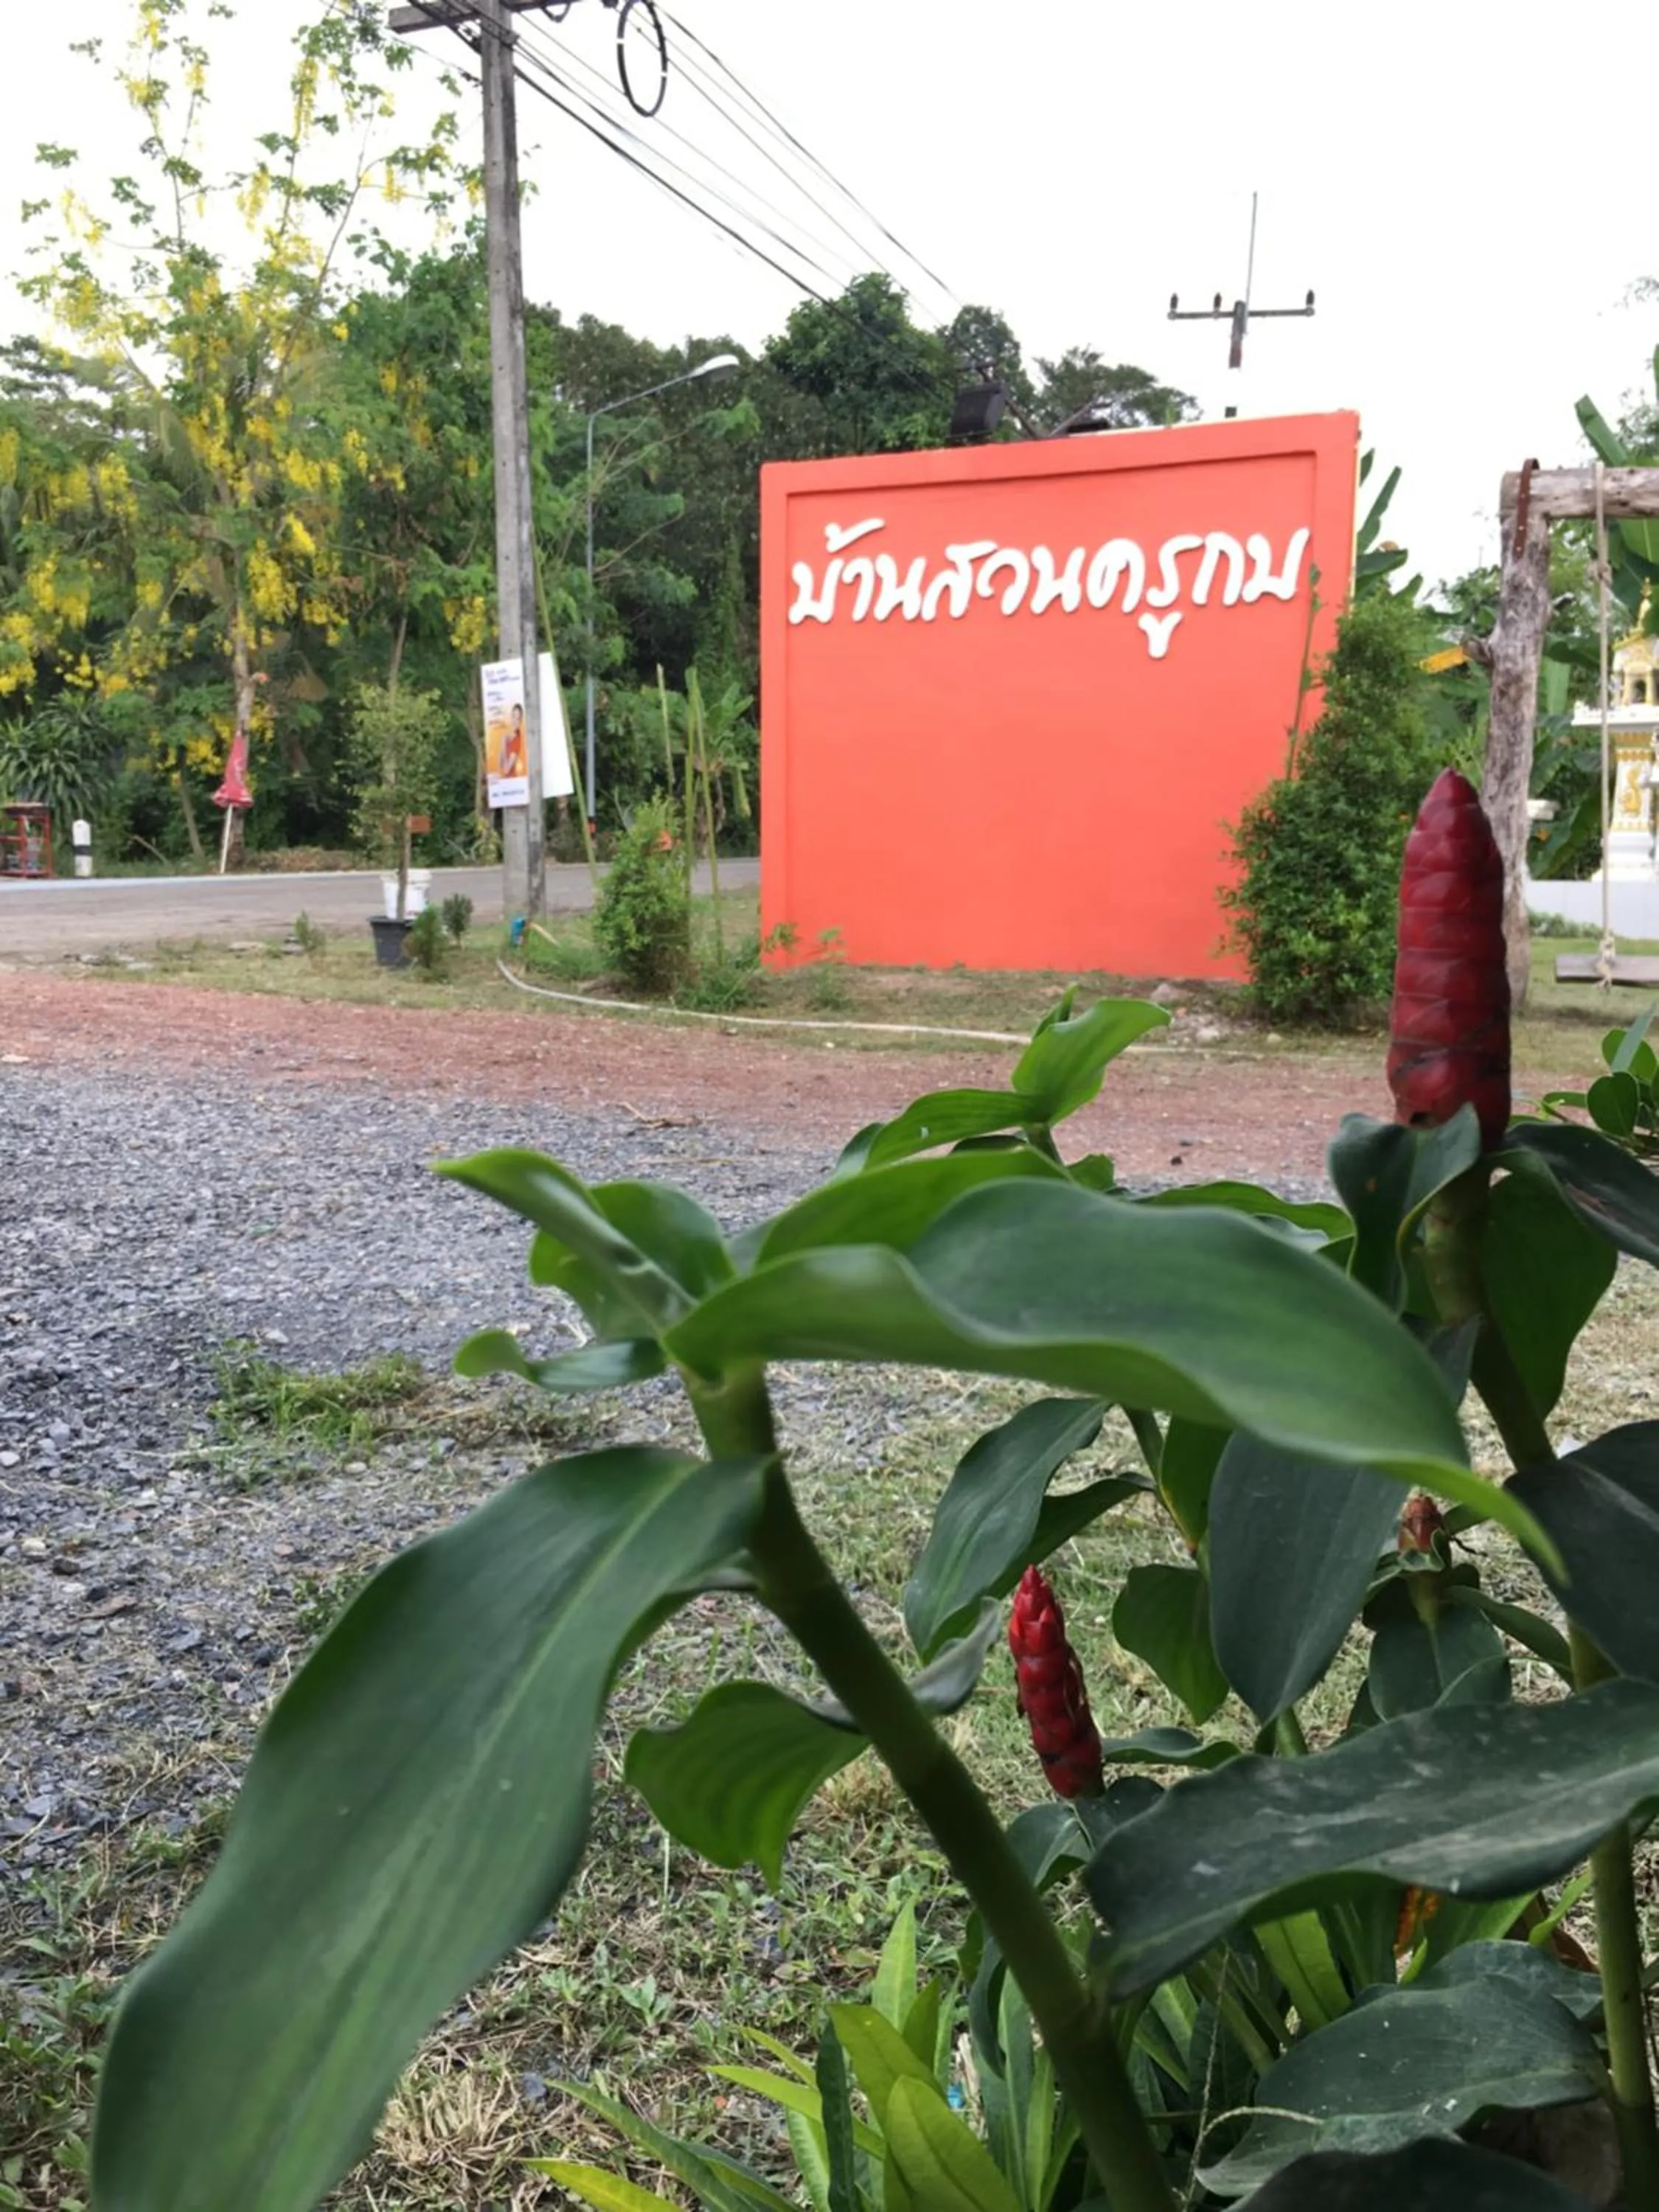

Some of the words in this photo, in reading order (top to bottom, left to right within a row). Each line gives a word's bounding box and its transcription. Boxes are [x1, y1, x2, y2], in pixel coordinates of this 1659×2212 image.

[788, 517, 1310, 658] บ้านสวนครูกบ
